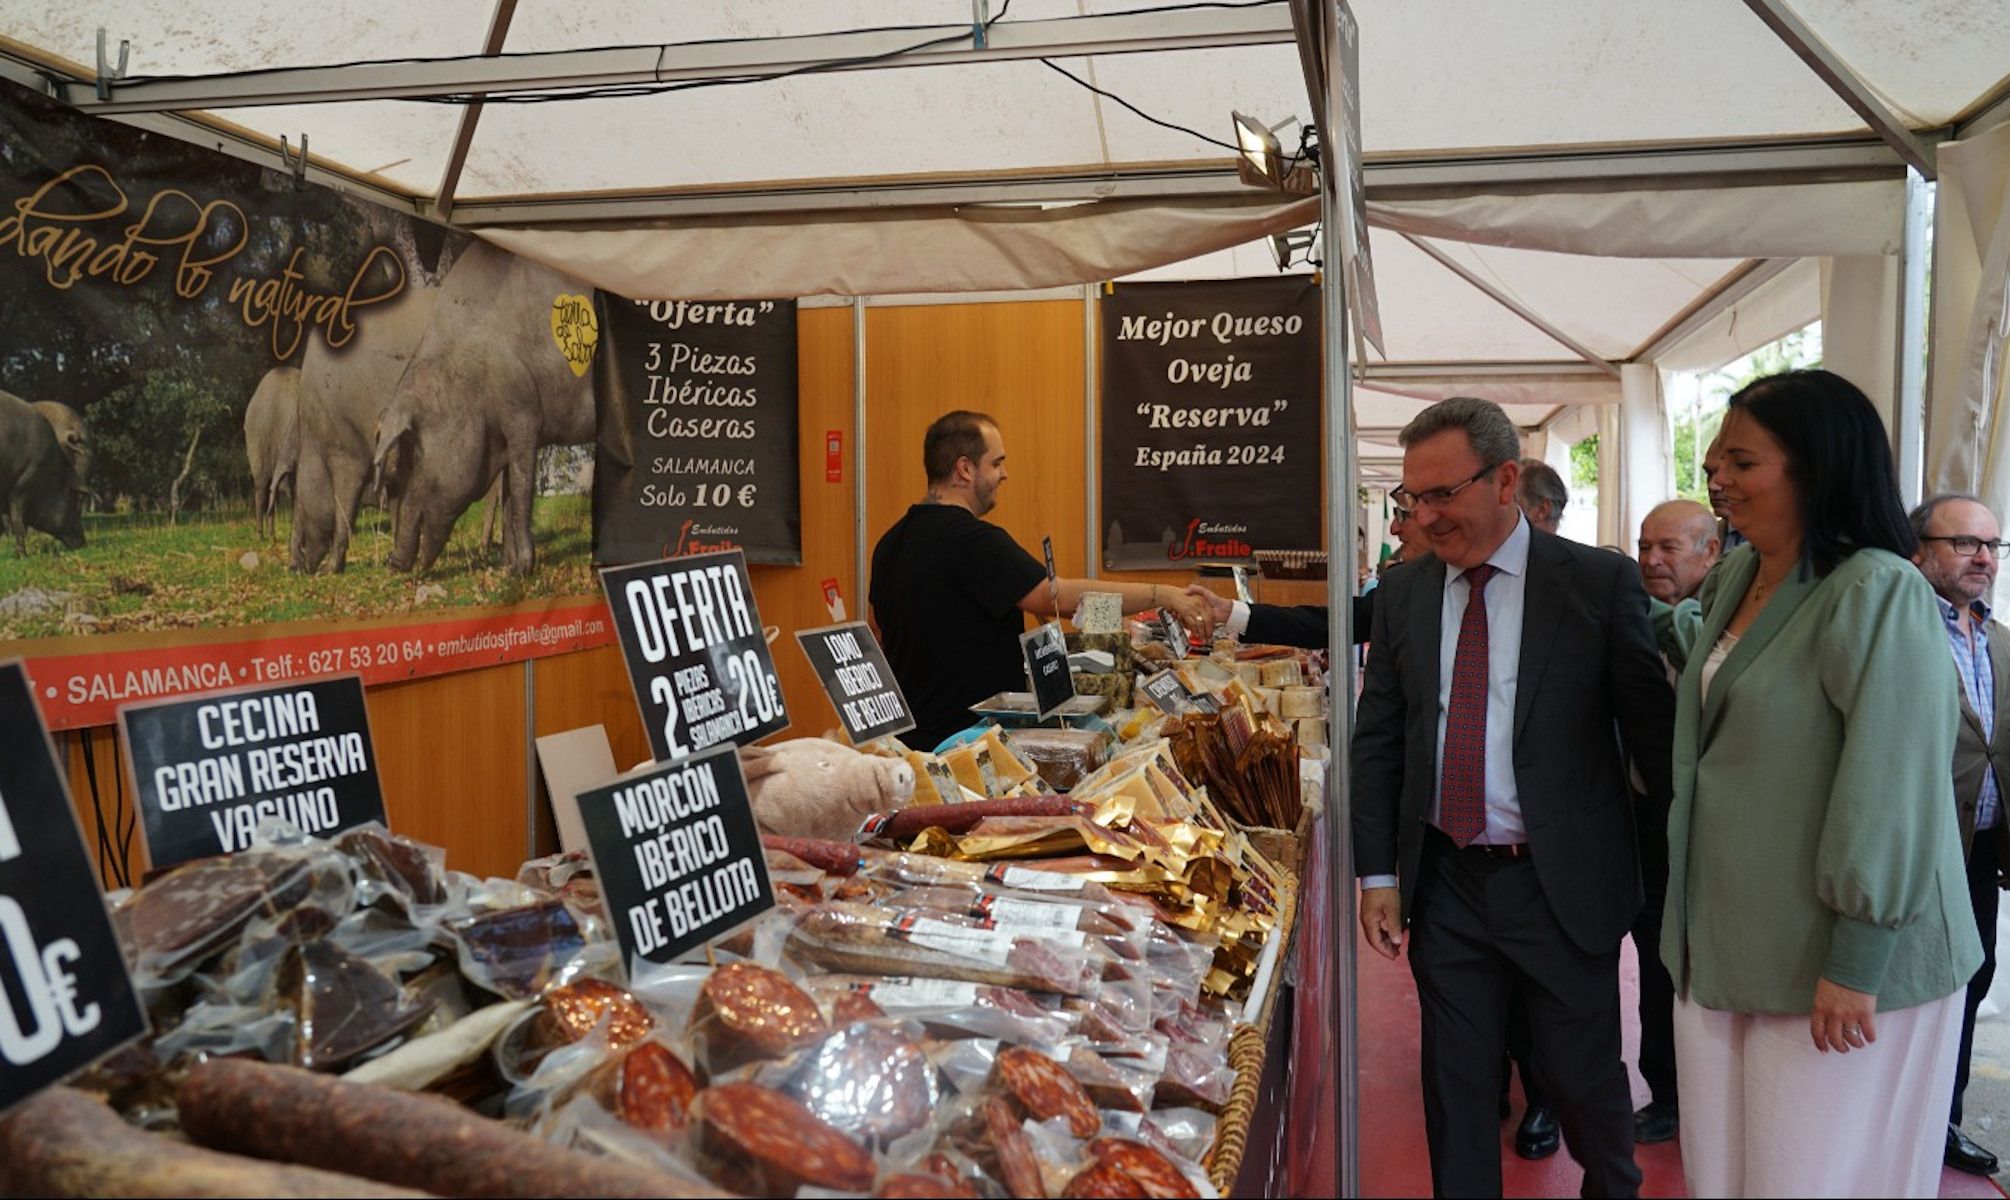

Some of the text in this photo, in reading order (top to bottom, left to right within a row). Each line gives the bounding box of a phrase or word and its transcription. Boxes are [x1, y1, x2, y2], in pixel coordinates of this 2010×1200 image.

[176, 200, 248, 298] lo
[228, 246, 405, 361] natural
[1117, 312, 1303, 345] Mejor Queso
[644, 343, 757, 375] 3 Piezas
[1167, 355, 1253, 388] Oveja
[643, 375, 757, 407] Ibéricas
[647, 408, 756, 439] Caseras
[1136, 400, 1288, 429] “Reserva”
[651, 457, 755, 475] SALAMANCA
[1134, 444, 1286, 471] España 2024
[640, 484, 757, 508] Solo 10 €
[690, 524, 738, 535] Embutidos
[1198, 522, 1247, 534] Embutidos
[625, 564, 753, 663] OFERTA
[67, 661, 234, 704] SALAMANCA
[251, 653, 305, 683] Telf.:
[308, 648, 343, 674] 627
[350, 646, 372, 668] 53
[377, 643, 399, 665] 20
[402, 640, 424, 661] 64
[437, 619, 605, 657] embutidosjfraile@gmail.com
[823, 632, 864, 664] LOMO
[673, 664, 710, 697] PIEZAS
[727, 650, 785, 731] 20€
[835, 661, 883, 697] IBÉRICO
[197, 690, 320, 750] CECINA
[650, 675, 690, 759] 2
[842, 691, 905, 732] DE BELLOTA
[154, 732, 368, 812] GRAN RESERVA
[612, 761, 720, 838] MORCÓN
[633, 814, 730, 892] IBÉRICO
[628, 857, 761, 956] DE BELLOTA
